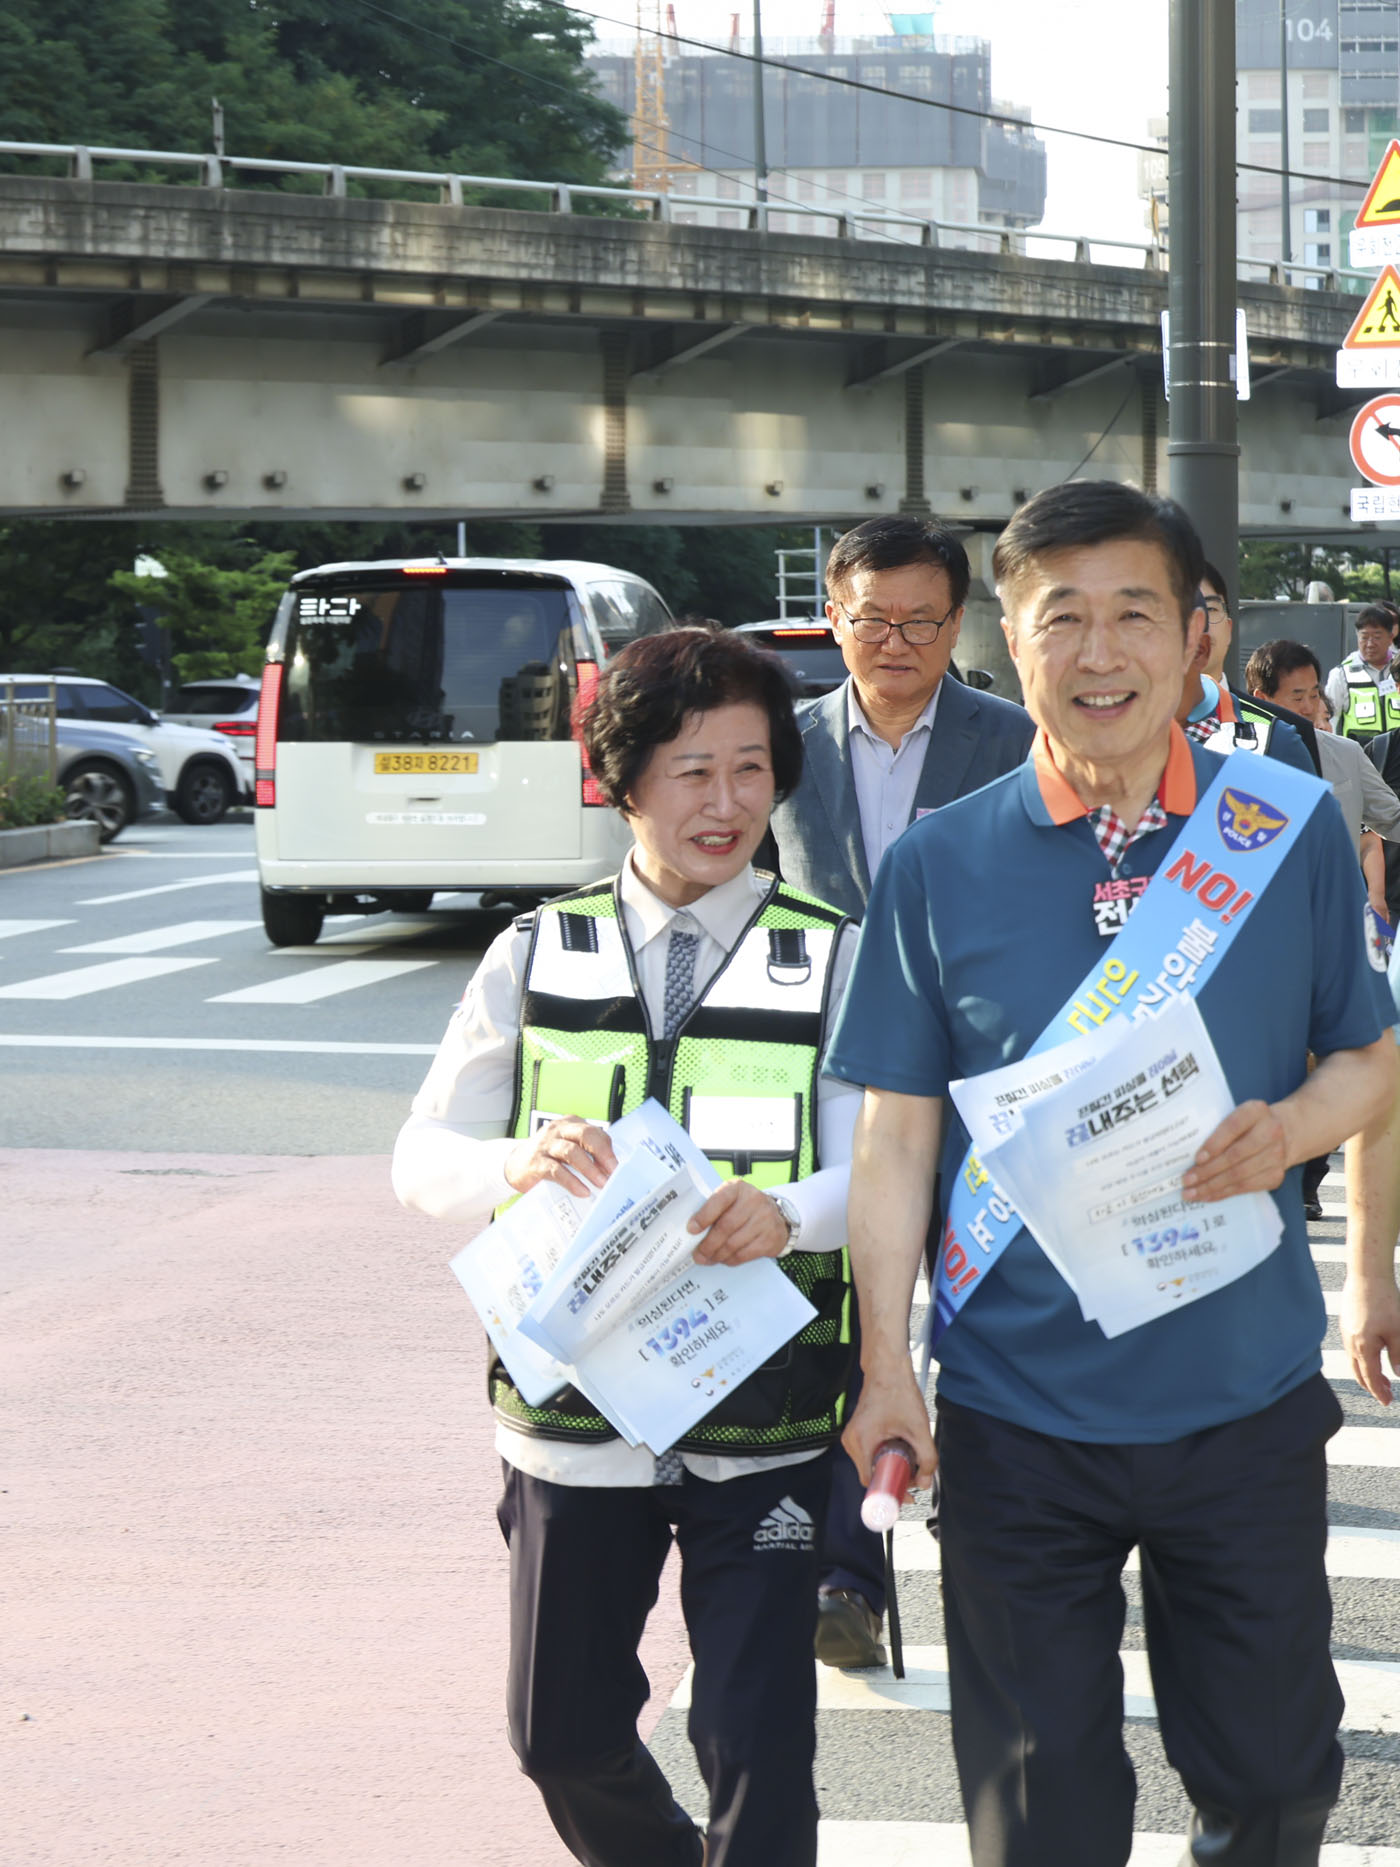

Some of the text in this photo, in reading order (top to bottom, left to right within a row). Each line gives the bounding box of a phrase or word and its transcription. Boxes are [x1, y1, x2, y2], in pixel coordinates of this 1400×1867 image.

[1286, 18, 1333, 42] 104
[428, 755, 471, 771] 8221
[1222, 826, 1252, 849] POLICE
[1093, 876, 1153, 902] 서초구
[1165, 848, 1255, 925] NO!
[1093, 900, 1141, 937] 전
[1161, 1053, 1200, 1098] 선택
[1131, 1221, 1200, 1256] 1394
[636, 1281, 701, 1329] 의심된다면,
[645, 1303, 709, 1358] 1394
[668, 1319, 730, 1370] 확인하세요
[753, 1521, 816, 1543] adida
